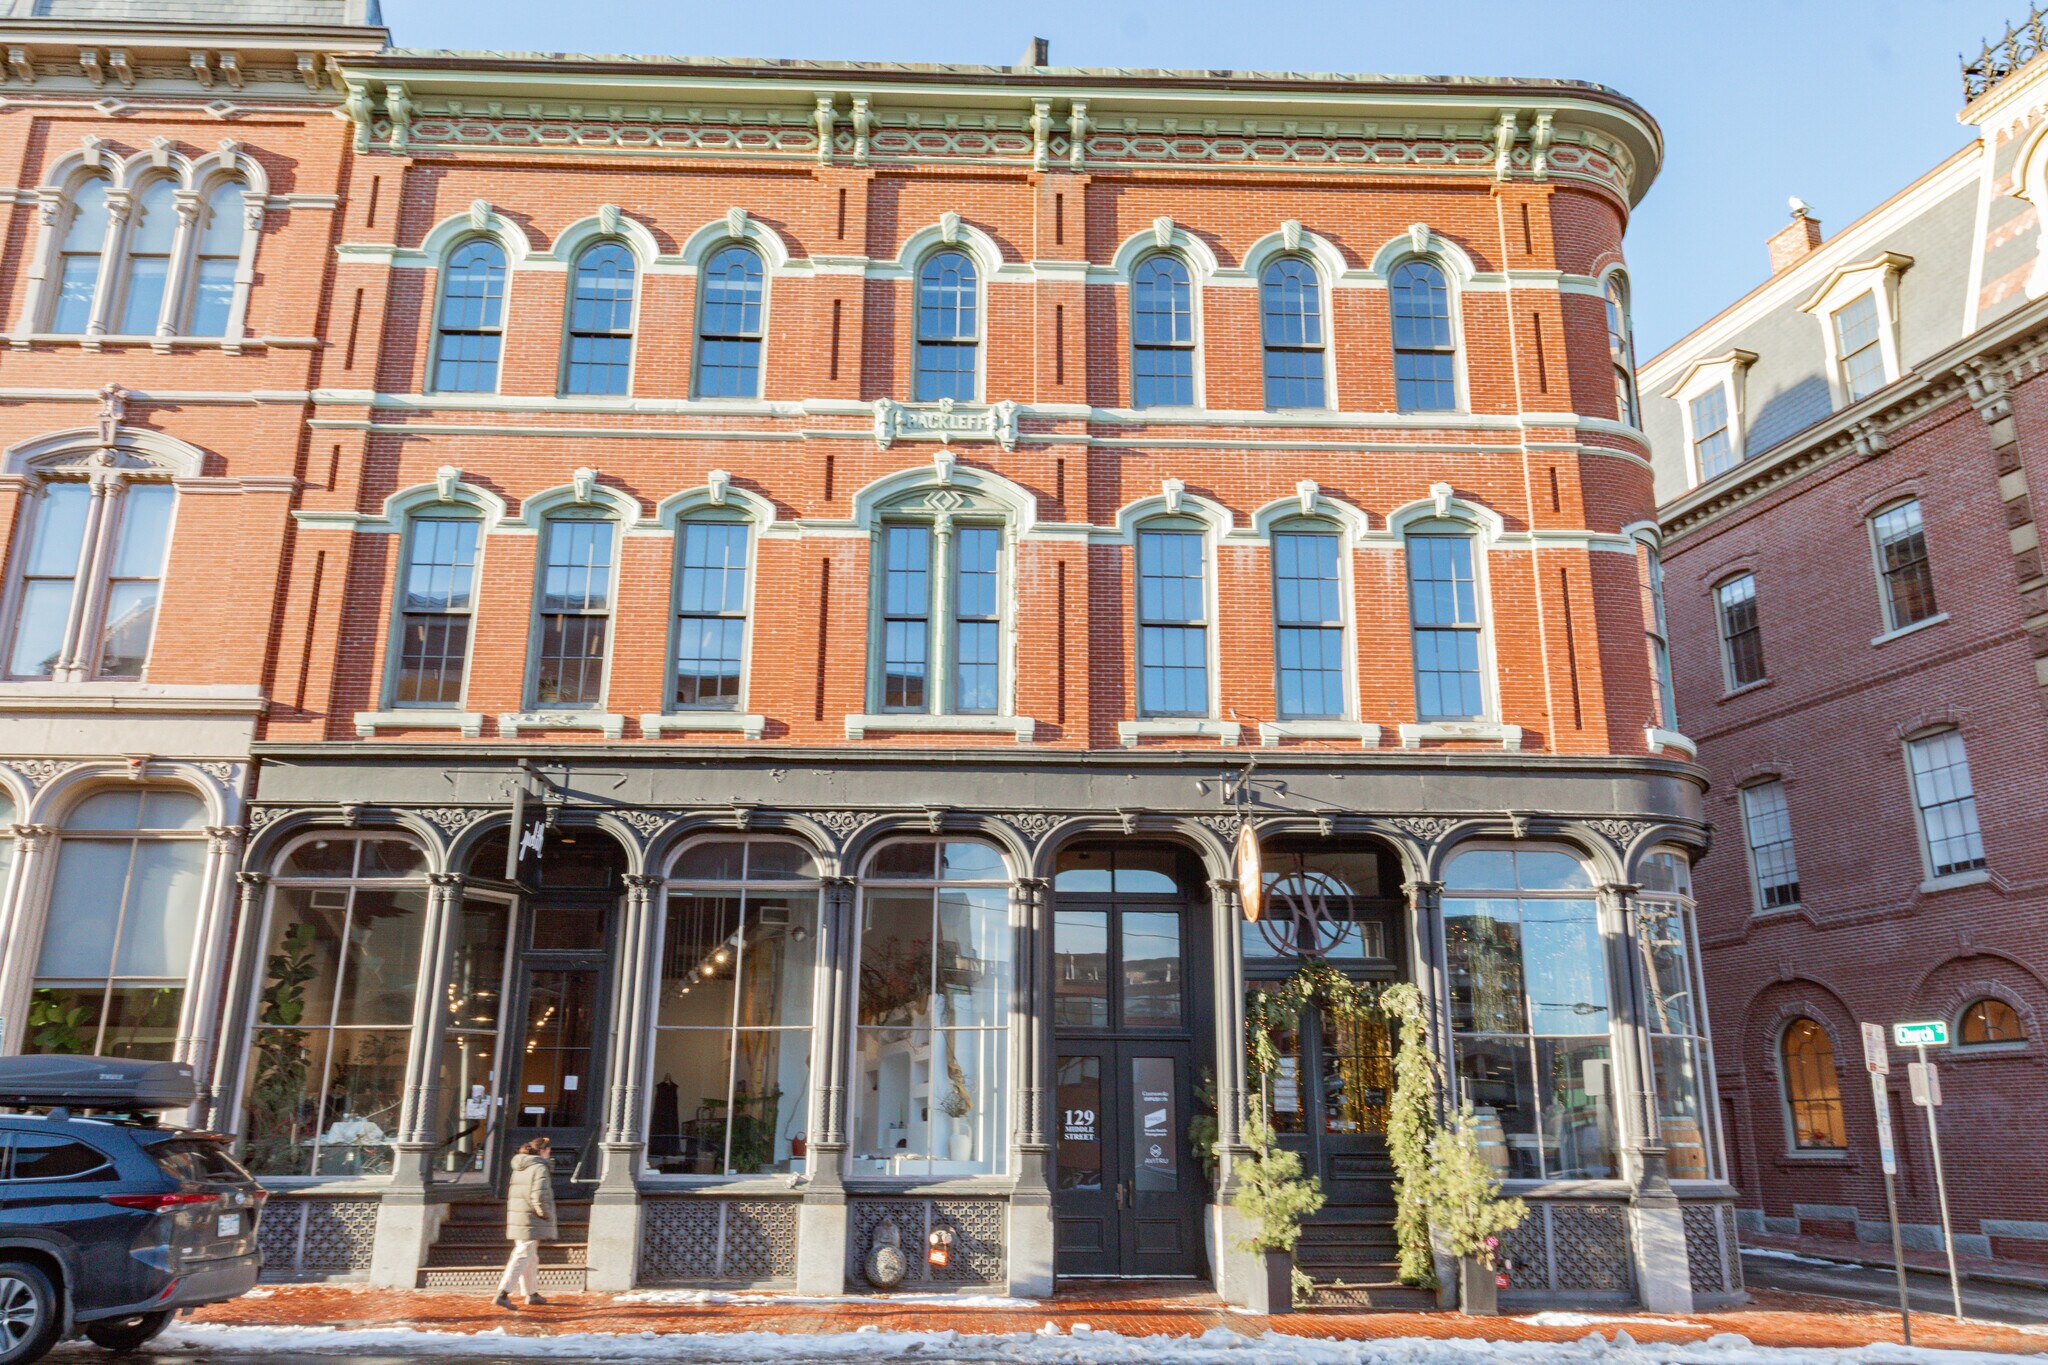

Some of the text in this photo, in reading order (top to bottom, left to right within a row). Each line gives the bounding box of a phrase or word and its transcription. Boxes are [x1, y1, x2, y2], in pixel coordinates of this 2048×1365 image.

[907, 413, 987, 429] RACKLEFF
[1898, 1026, 1935, 1043] Church
[1064, 1109, 1095, 1126] 129
